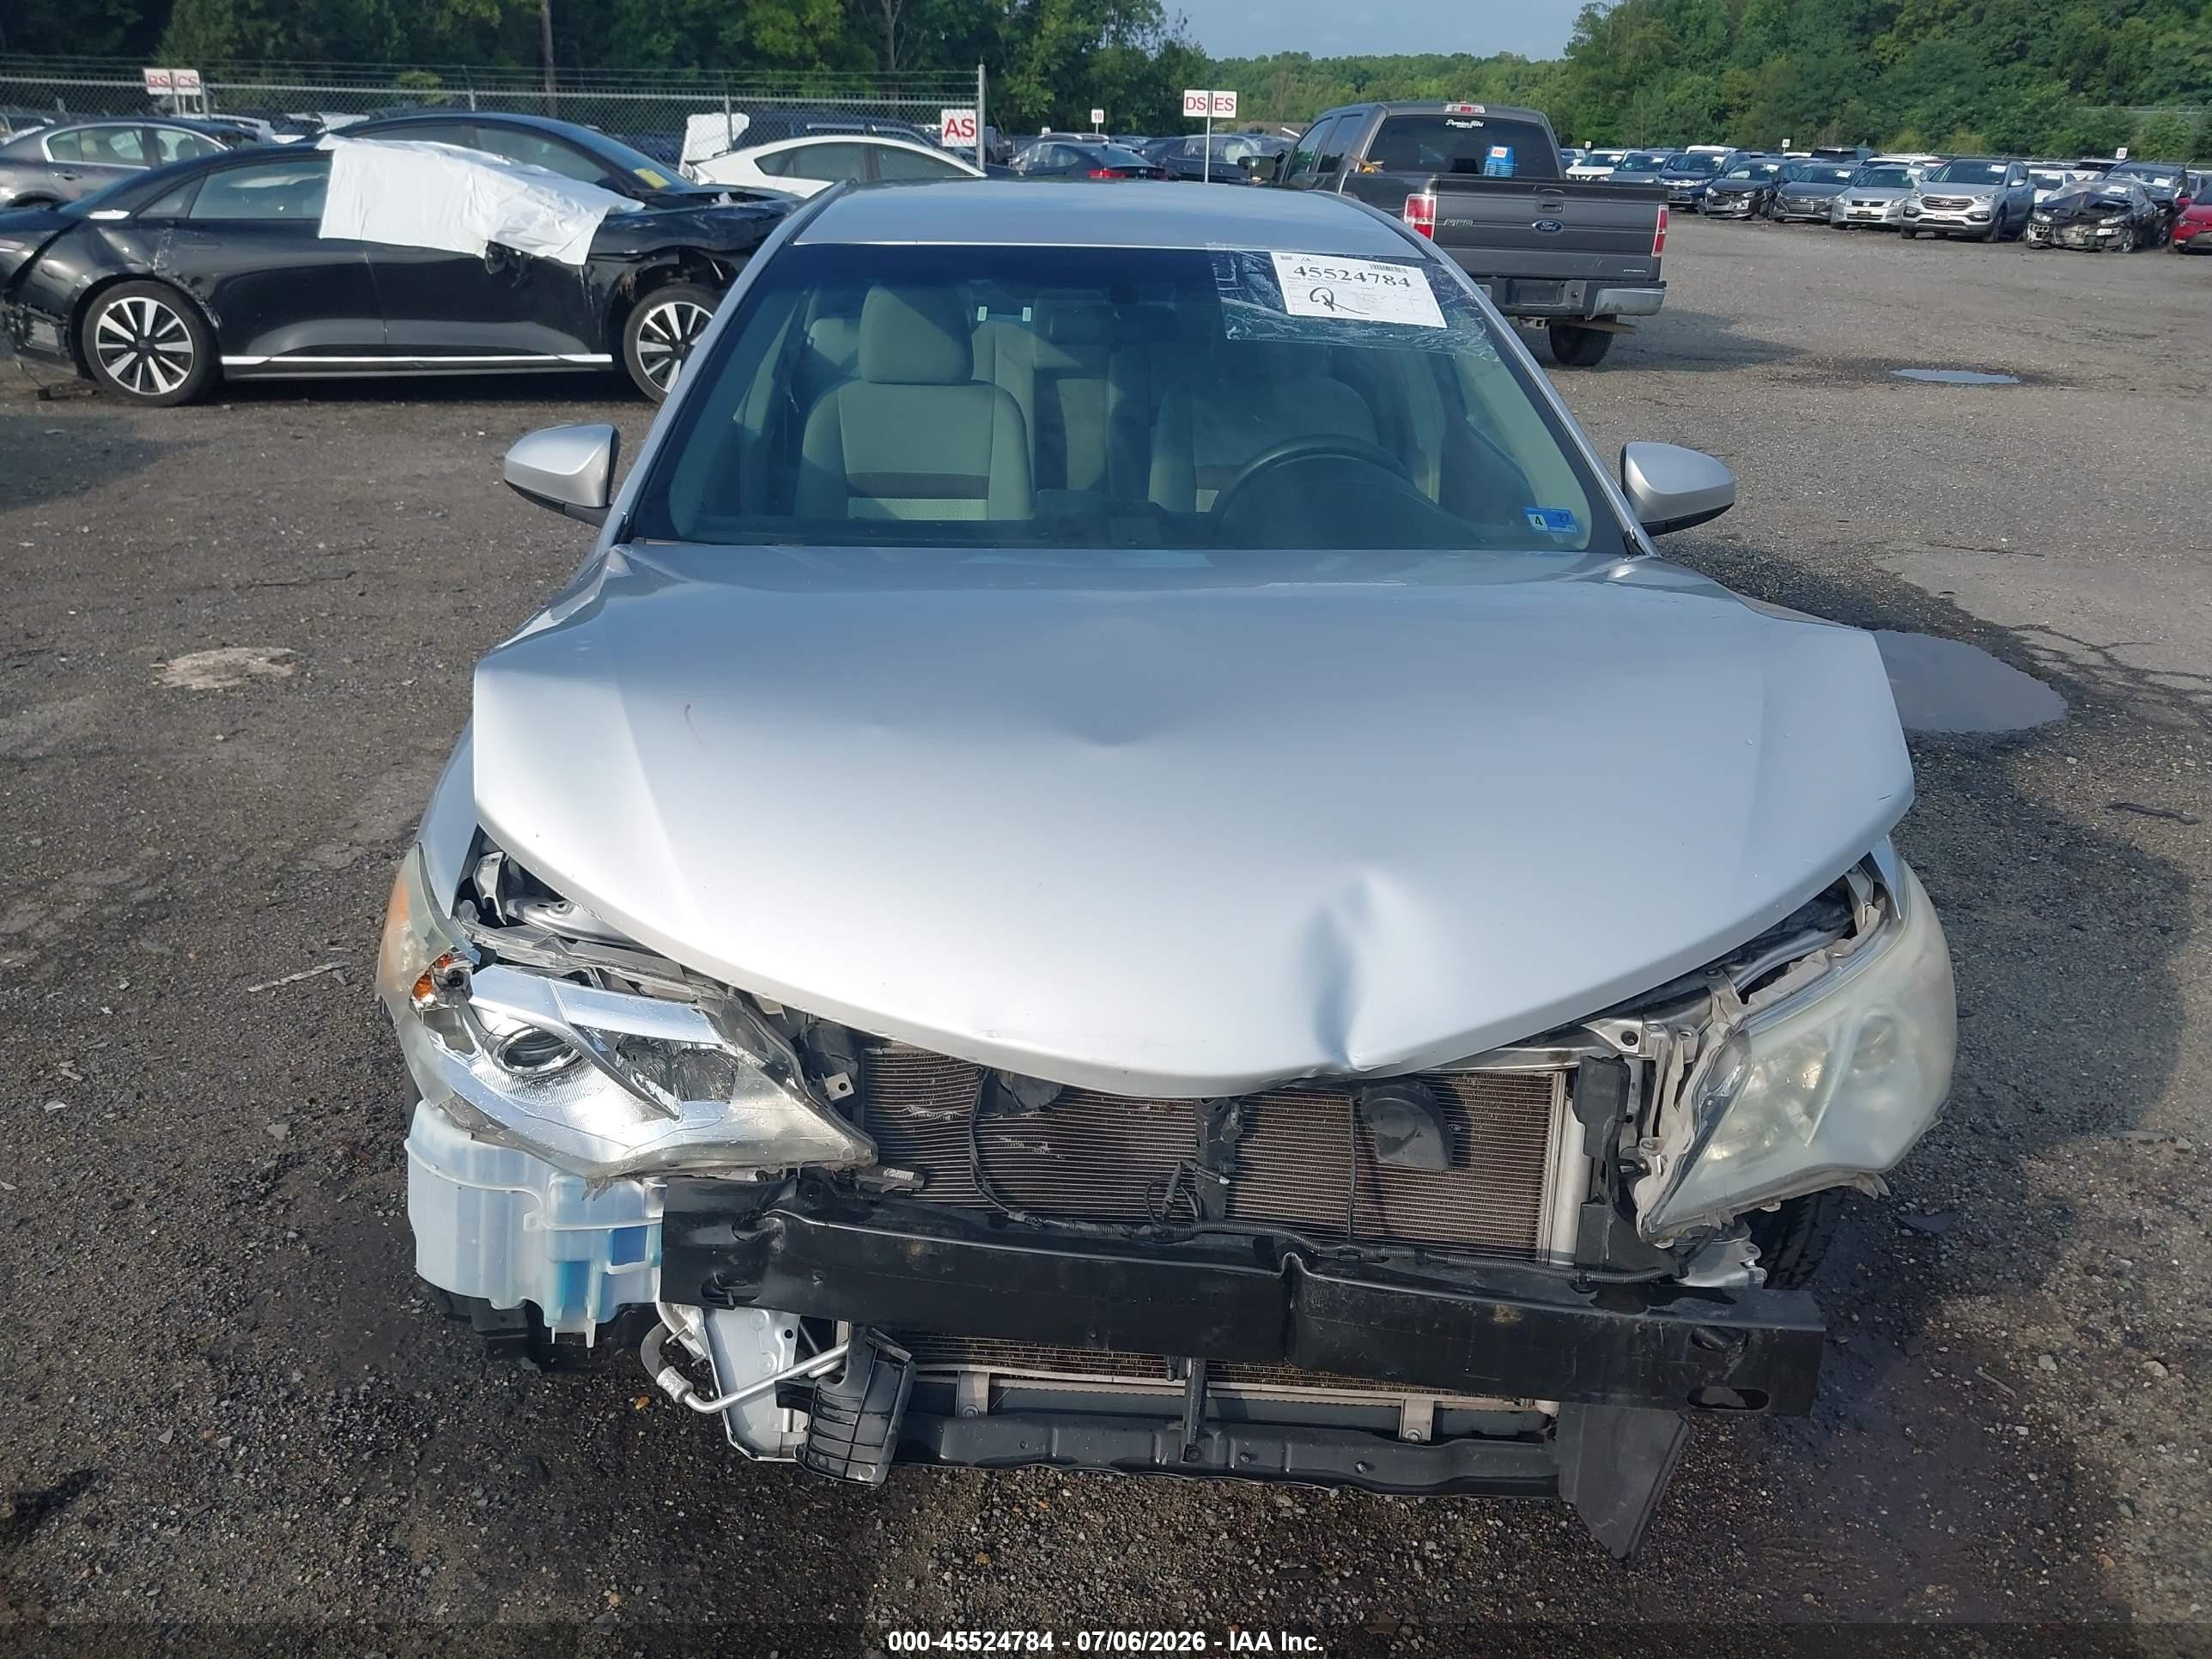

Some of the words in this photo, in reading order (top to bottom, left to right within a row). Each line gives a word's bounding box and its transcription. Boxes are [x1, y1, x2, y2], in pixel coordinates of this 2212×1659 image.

[1185, 96, 1206, 110] DS
[1214, 97, 1235, 111] ES
[944, 118, 975, 138] AS
[1540, 222, 1559, 231] Ford
[1293, 265, 1412, 288] 45524784
[1534, 515, 1543, 526] 4
